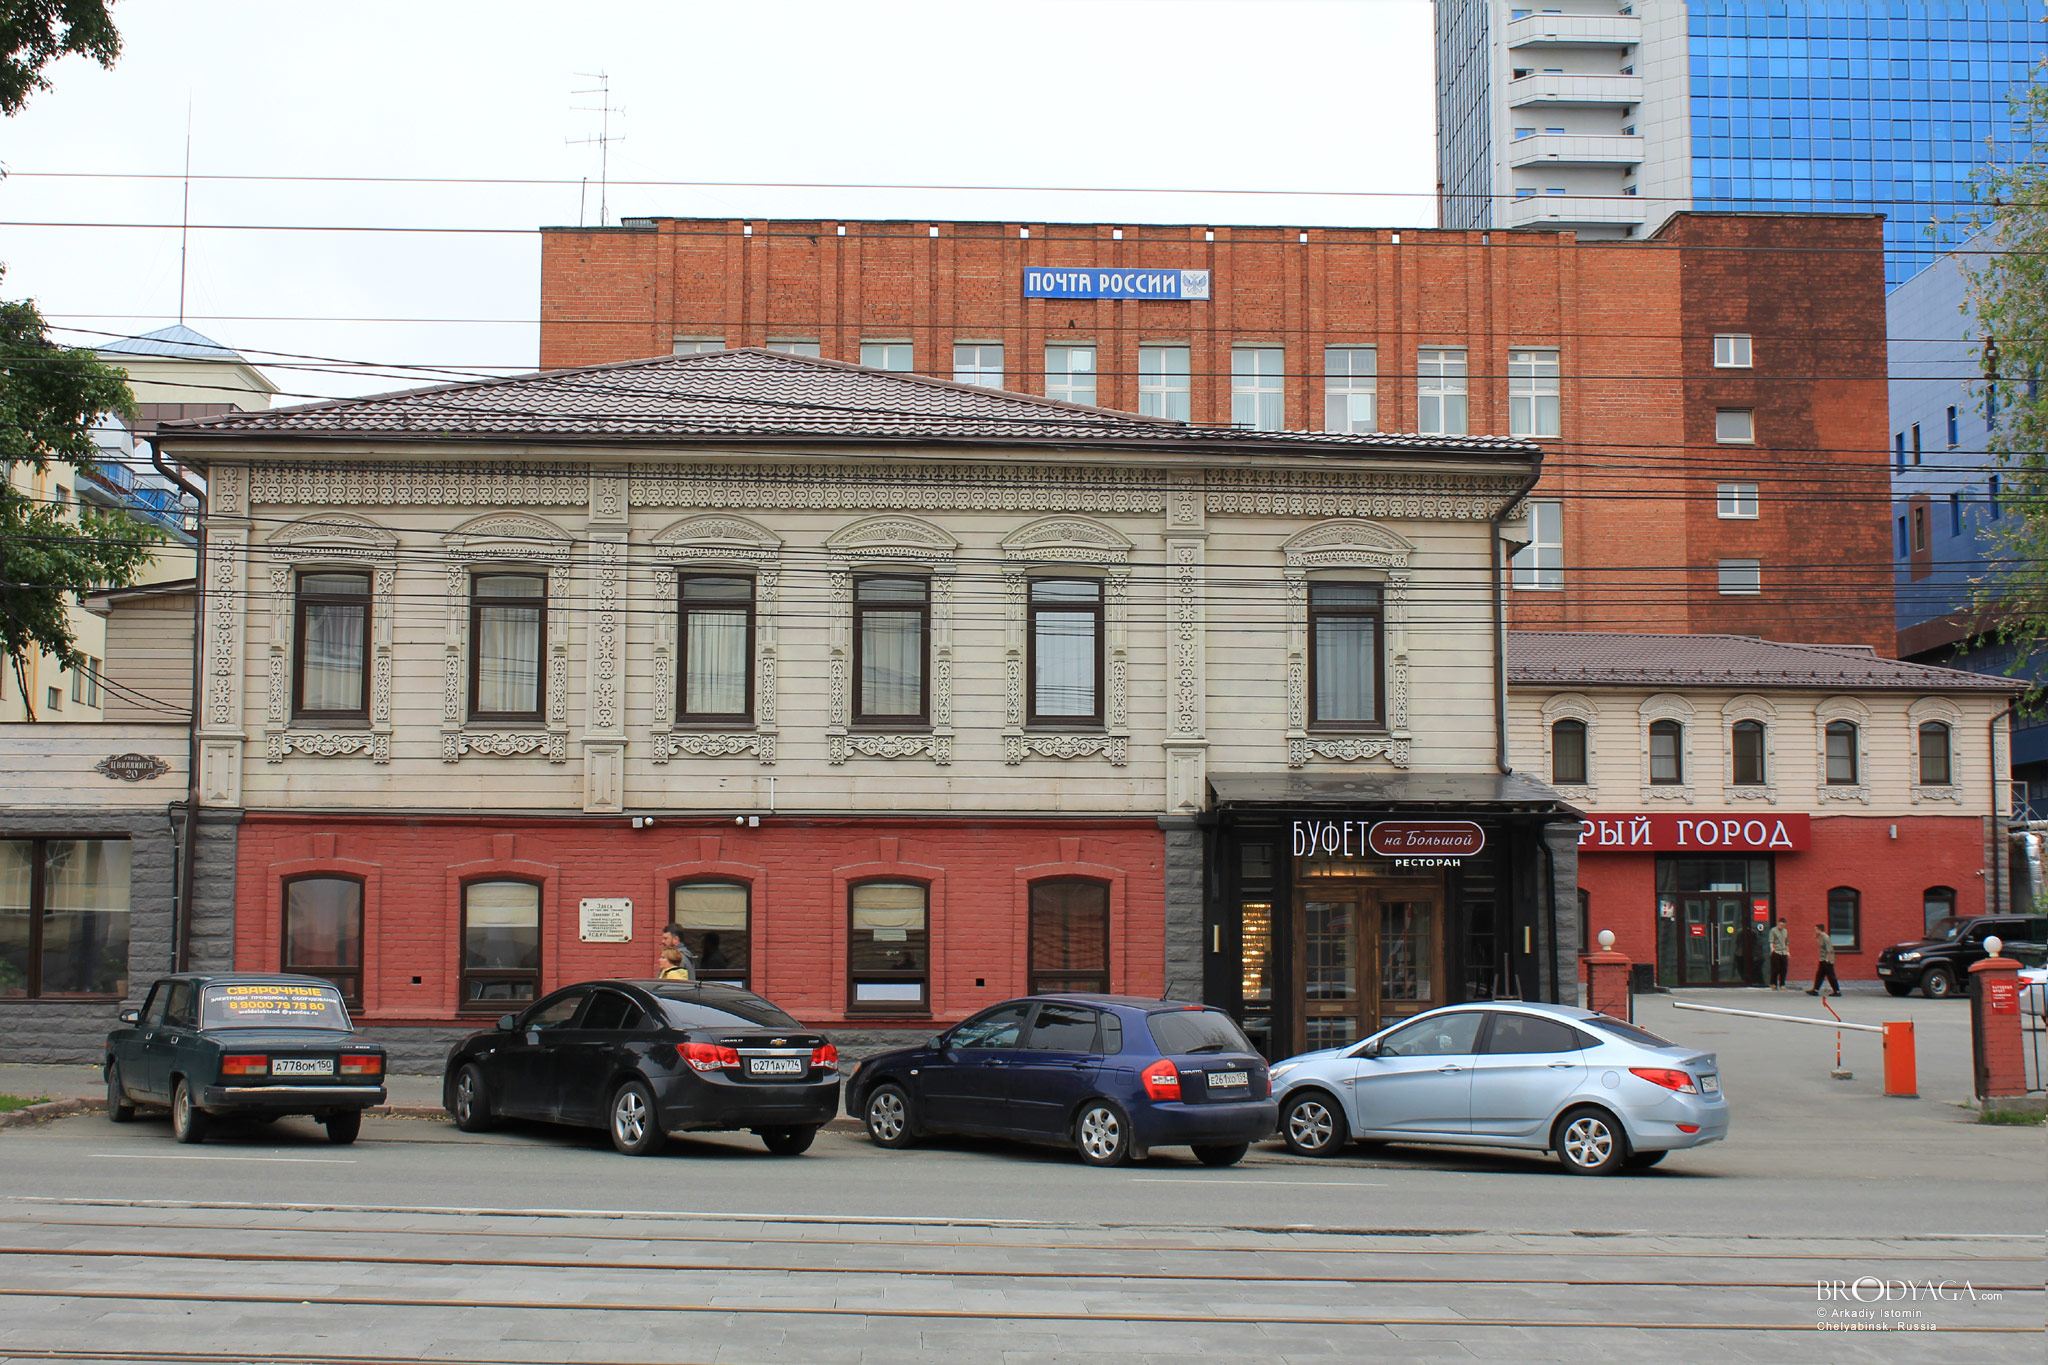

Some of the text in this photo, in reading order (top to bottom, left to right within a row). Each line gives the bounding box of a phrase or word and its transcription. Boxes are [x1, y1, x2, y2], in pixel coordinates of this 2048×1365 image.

[1028, 272, 1176, 294] ПОЧТА РОССИИ
[110, 761, 154, 770] ЦВИЛЛИНГА
[126, 769, 139, 779] 20
[1293, 821, 1474, 857] БУФЕТ на Большой
[1676, 820, 1793, 848] ГОРОД
[1395, 858, 1461, 867] РЕСТОРАН
[226, 986, 322, 997] СВАРОЧНЫЕ
[229, 1001, 326, 1011] 8 9000 79 79 80
